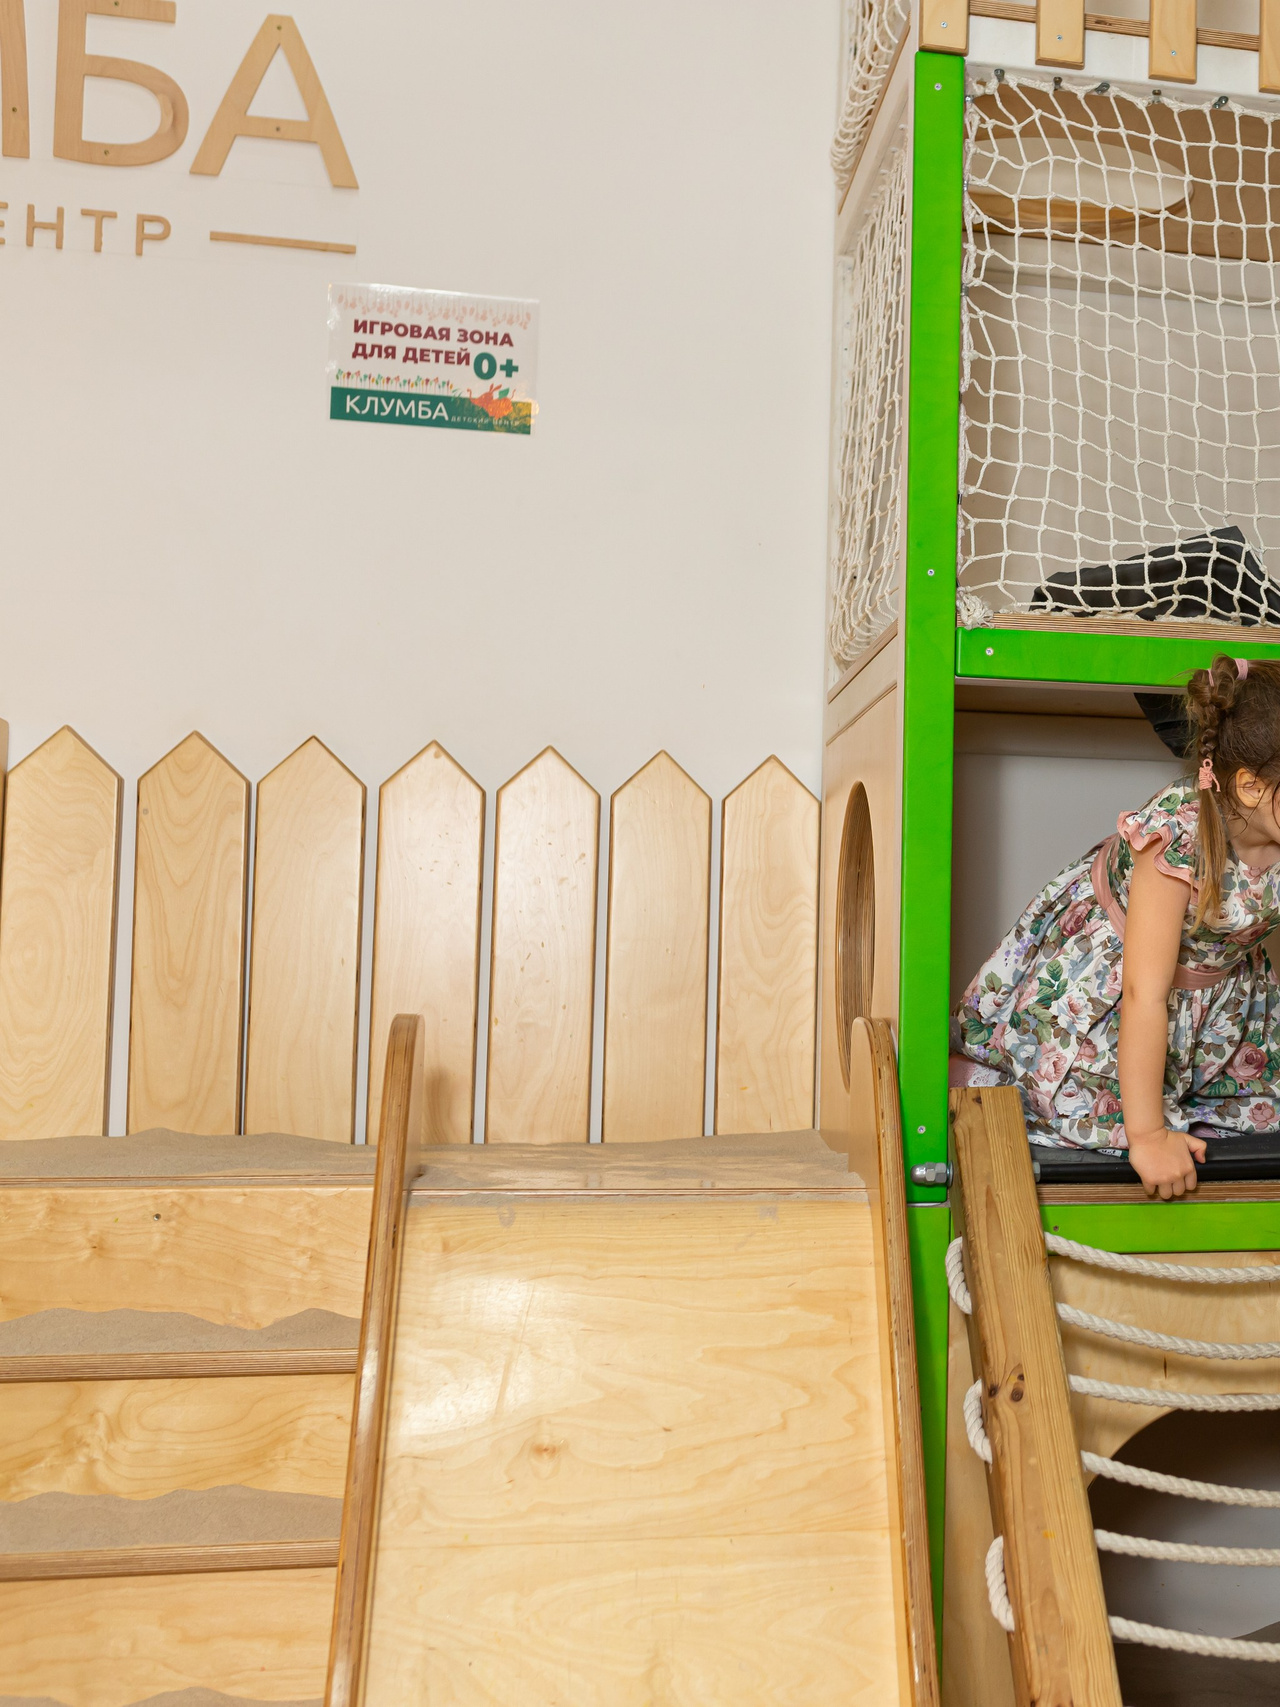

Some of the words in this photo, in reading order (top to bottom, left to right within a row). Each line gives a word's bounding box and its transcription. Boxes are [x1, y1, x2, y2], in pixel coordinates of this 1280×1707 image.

[0, 0, 359, 190] БА
[353, 318, 451, 342] ИГРОВАЯ
[456, 327, 514, 348] ЗОНА
[352, 342, 397, 360] ДЛЯ
[402, 347, 471, 367] ДЕТЕЙ
[473, 351, 520, 381] 0+
[345, 393, 450, 422] КЛУМБА
